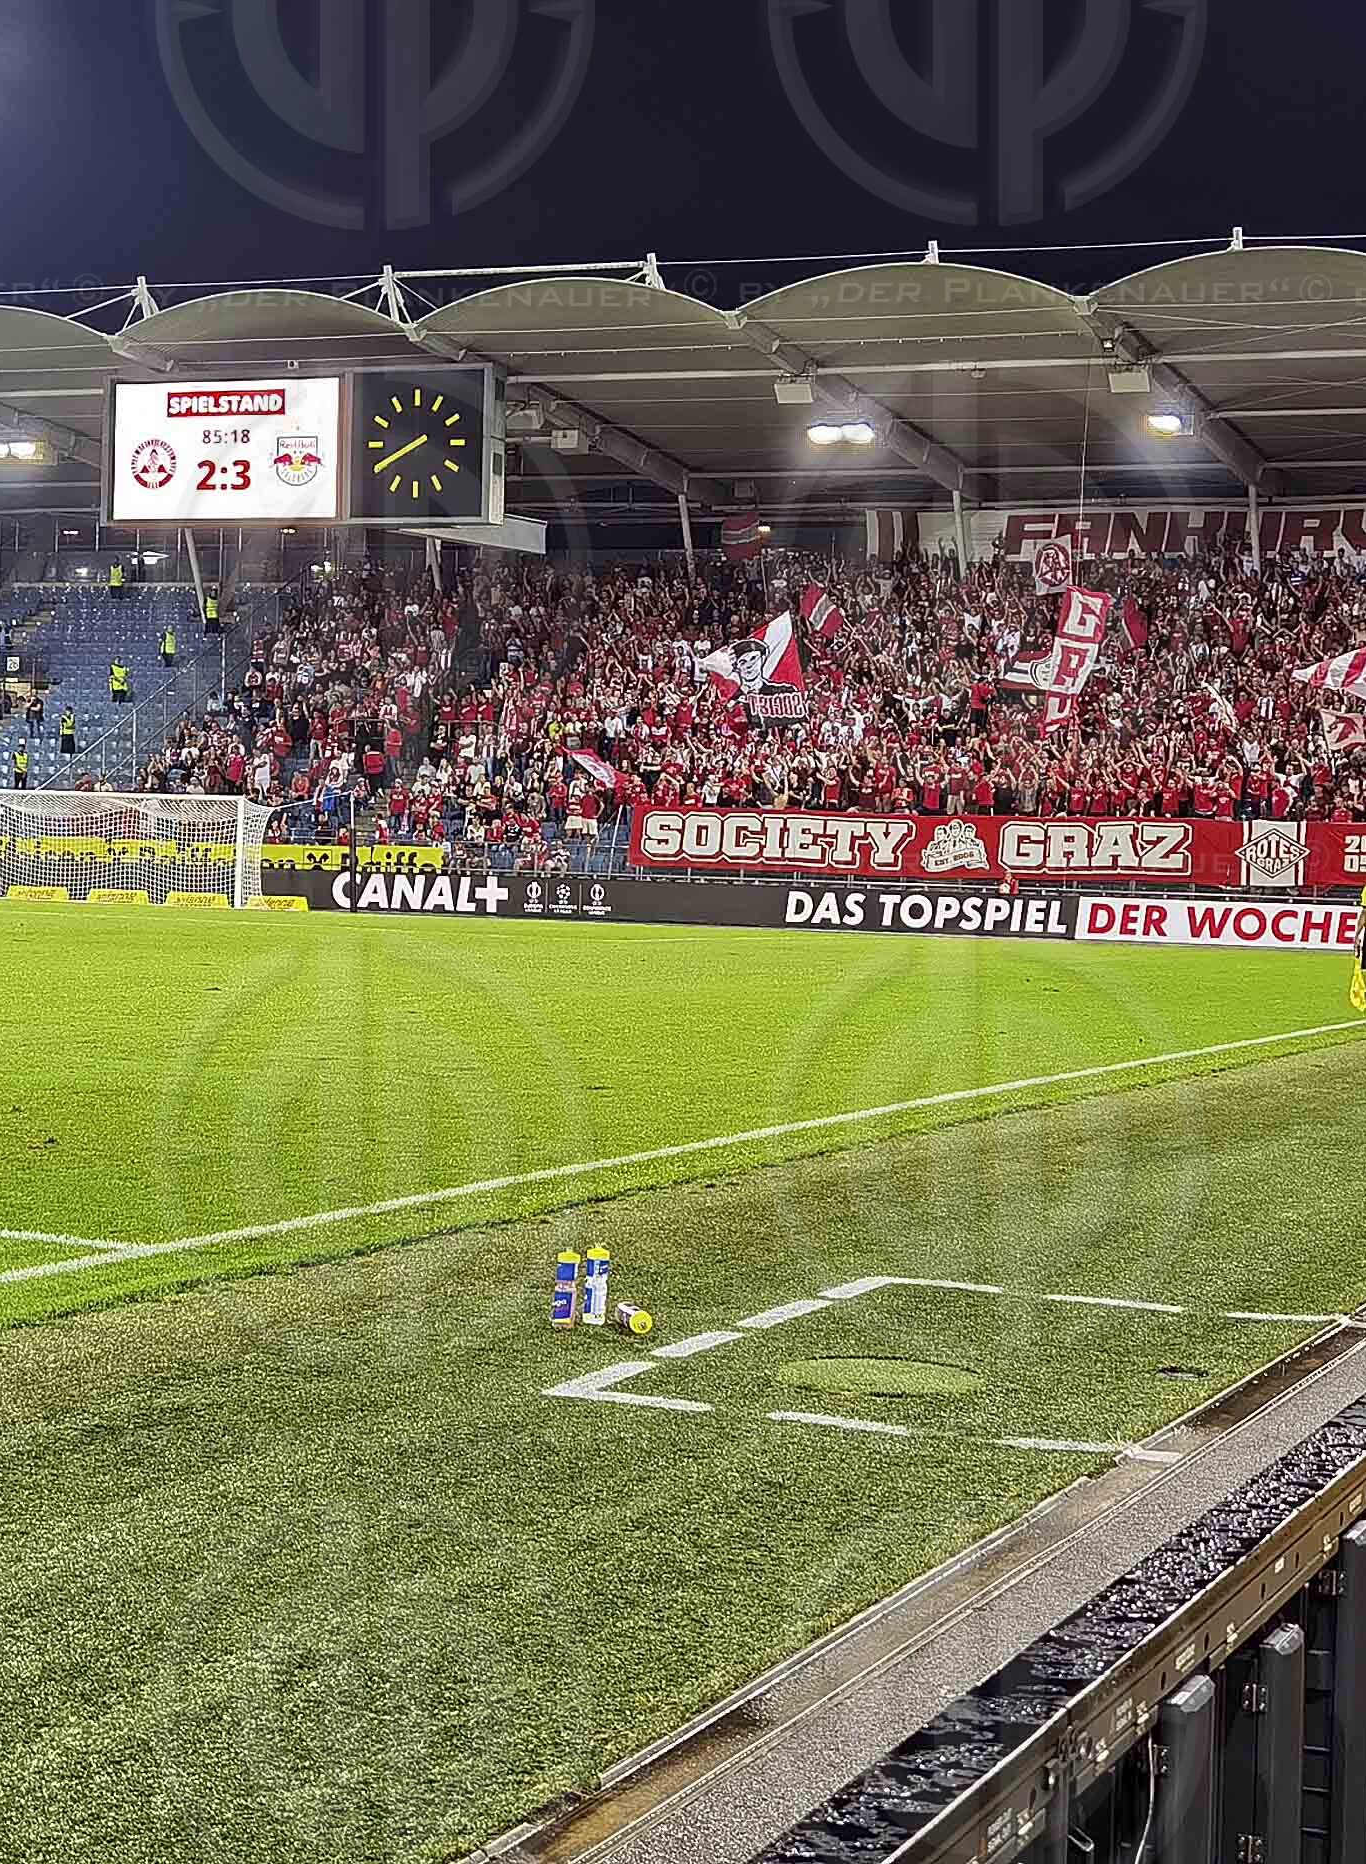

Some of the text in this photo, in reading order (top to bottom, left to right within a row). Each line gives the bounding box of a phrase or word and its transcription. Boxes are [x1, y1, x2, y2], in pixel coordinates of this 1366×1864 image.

[169, 394, 284, 415] SPIELSTAND
[202, 428, 251, 445] 85:18
[196, 459, 252, 491] 2:3
[641, 812, 1193, 877] SOCIETY GRAZ
[1245, 832, 1303, 862] ROTES
[331, 871, 510, 913] CANAL+
[785, 889, 1069, 935] DAS TOPSPIEL
[1087, 902, 1357, 945] DER WOCHE
